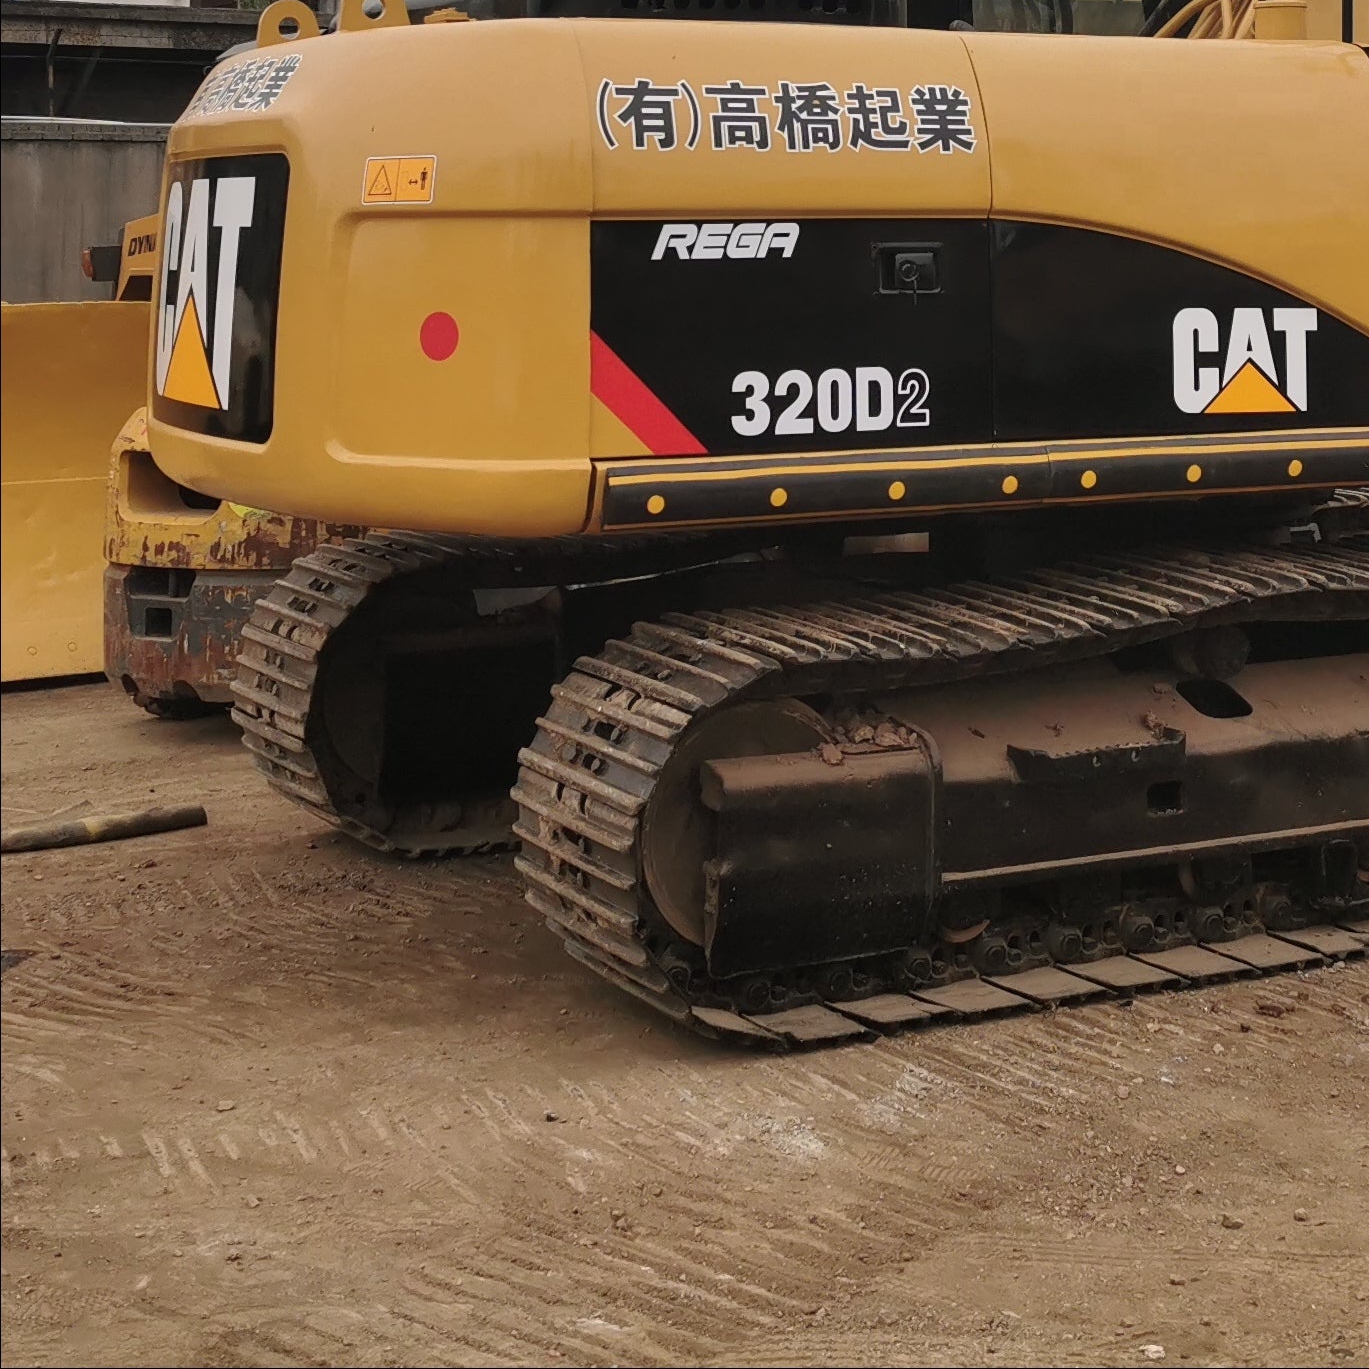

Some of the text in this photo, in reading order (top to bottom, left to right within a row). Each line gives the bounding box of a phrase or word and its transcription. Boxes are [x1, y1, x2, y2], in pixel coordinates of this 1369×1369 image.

[156, 176, 256, 411] CAT
[651, 222, 799, 260] REGA
[1172, 307, 1318, 414] CAT
